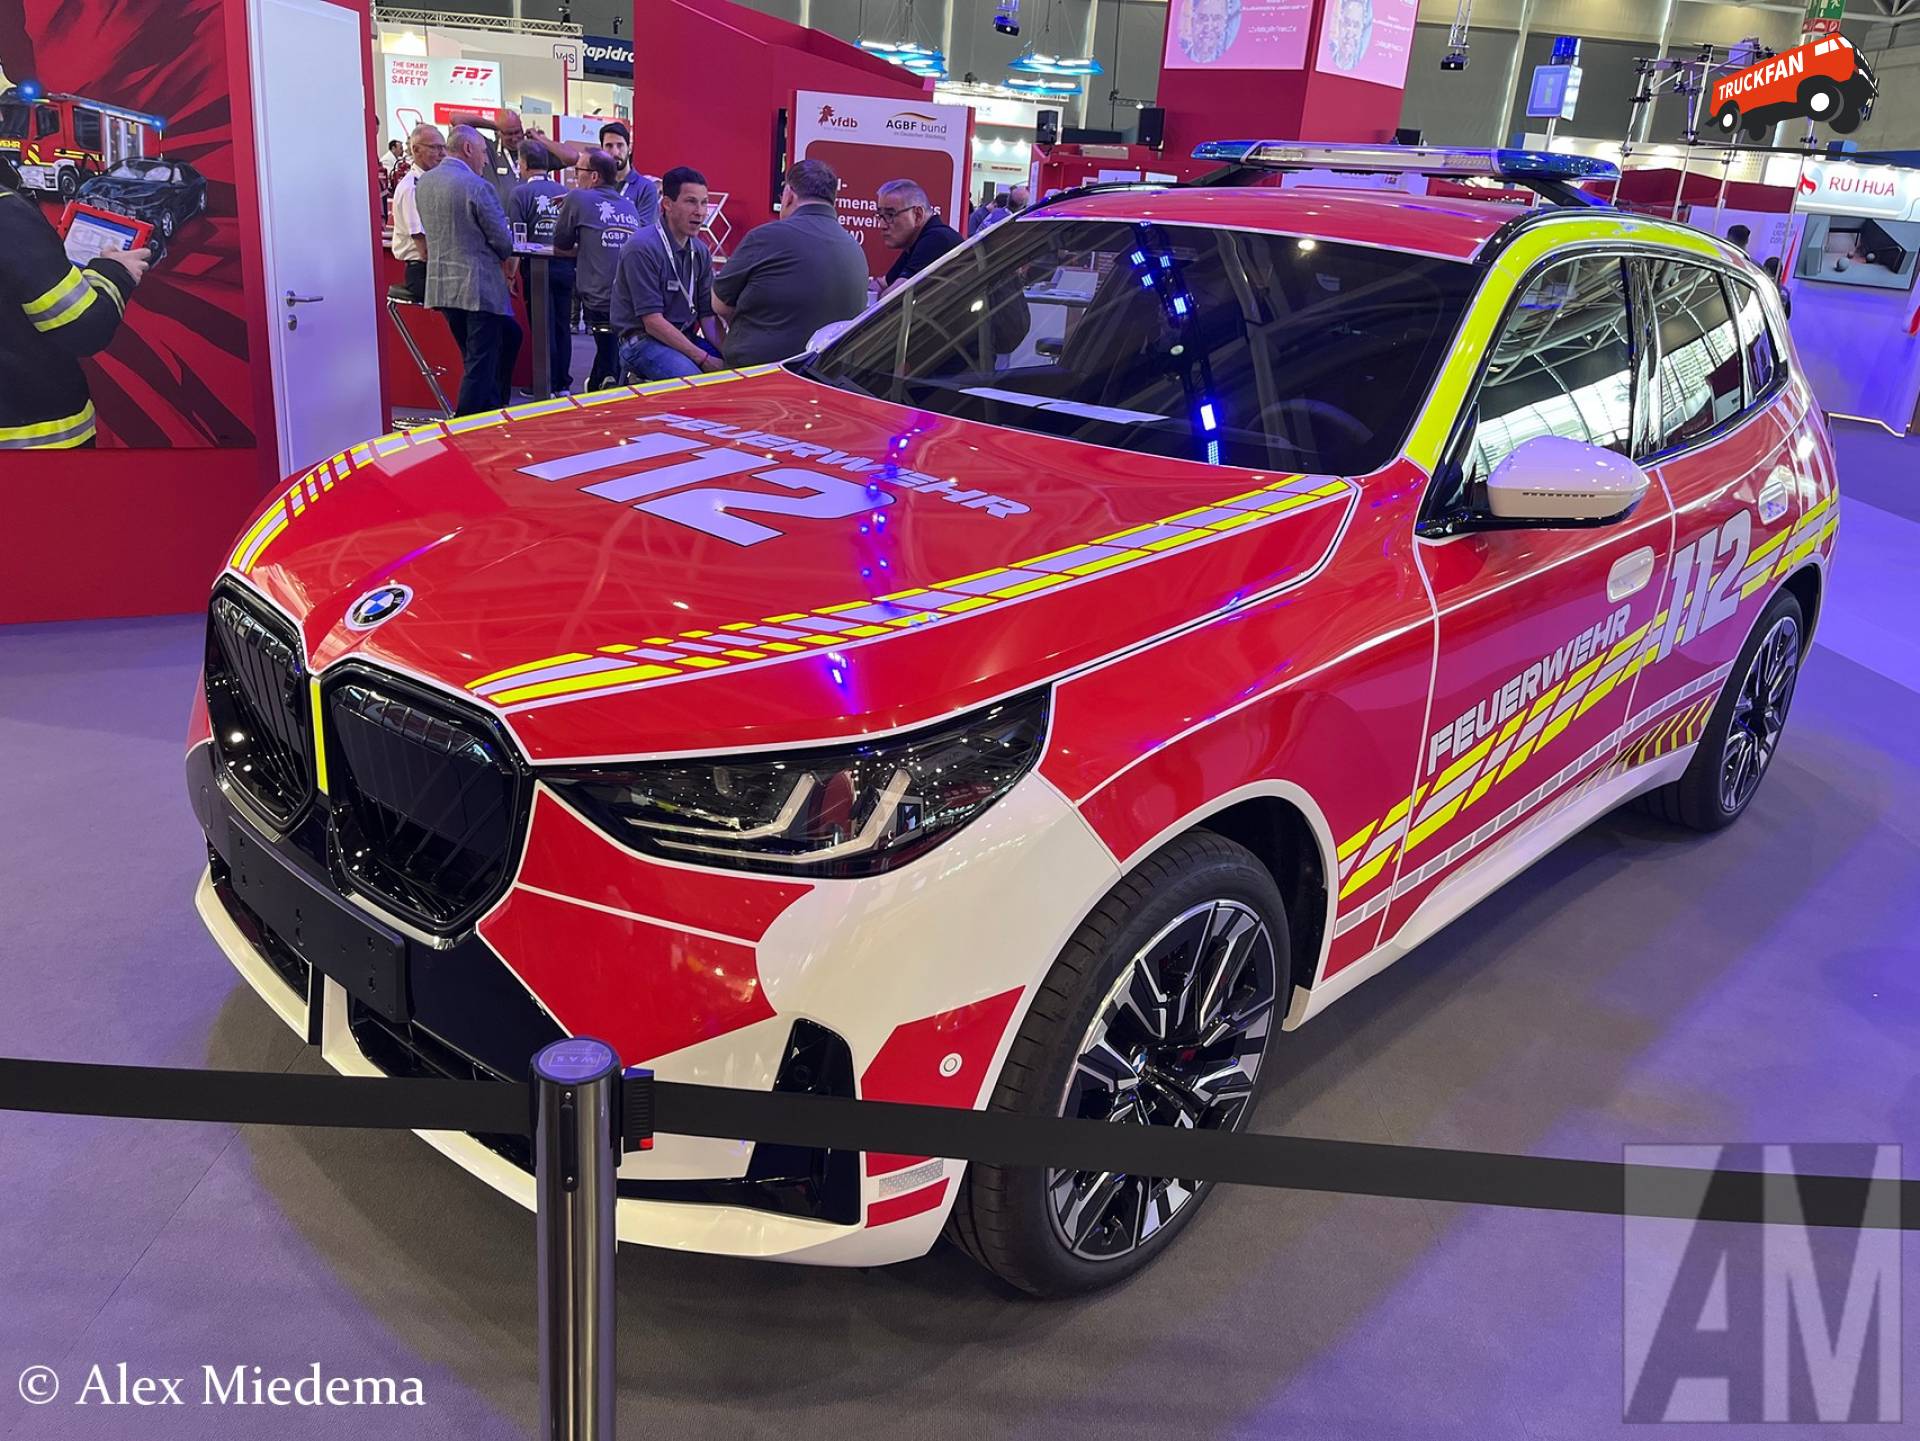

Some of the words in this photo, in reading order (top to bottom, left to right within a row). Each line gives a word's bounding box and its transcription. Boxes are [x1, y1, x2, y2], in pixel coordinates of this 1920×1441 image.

[392, 60, 404, 68] THE
[452, 66, 493, 80] FB7
[391, 75, 428, 86] SAFETY
[830, 117, 858, 128] vfdb
[885, 120, 917, 130] AGBF
[921, 123, 947, 134] bund
[1828, 176, 1895, 196] RUIHUA
[601, 231, 625, 240] AGBF
[635, 413, 1032, 518] FEUERWEHR
[515, 432, 896, 547] 112
[1427, 603, 1631, 776] FEUERWEHR
[1655, 508, 1751, 664] 112
